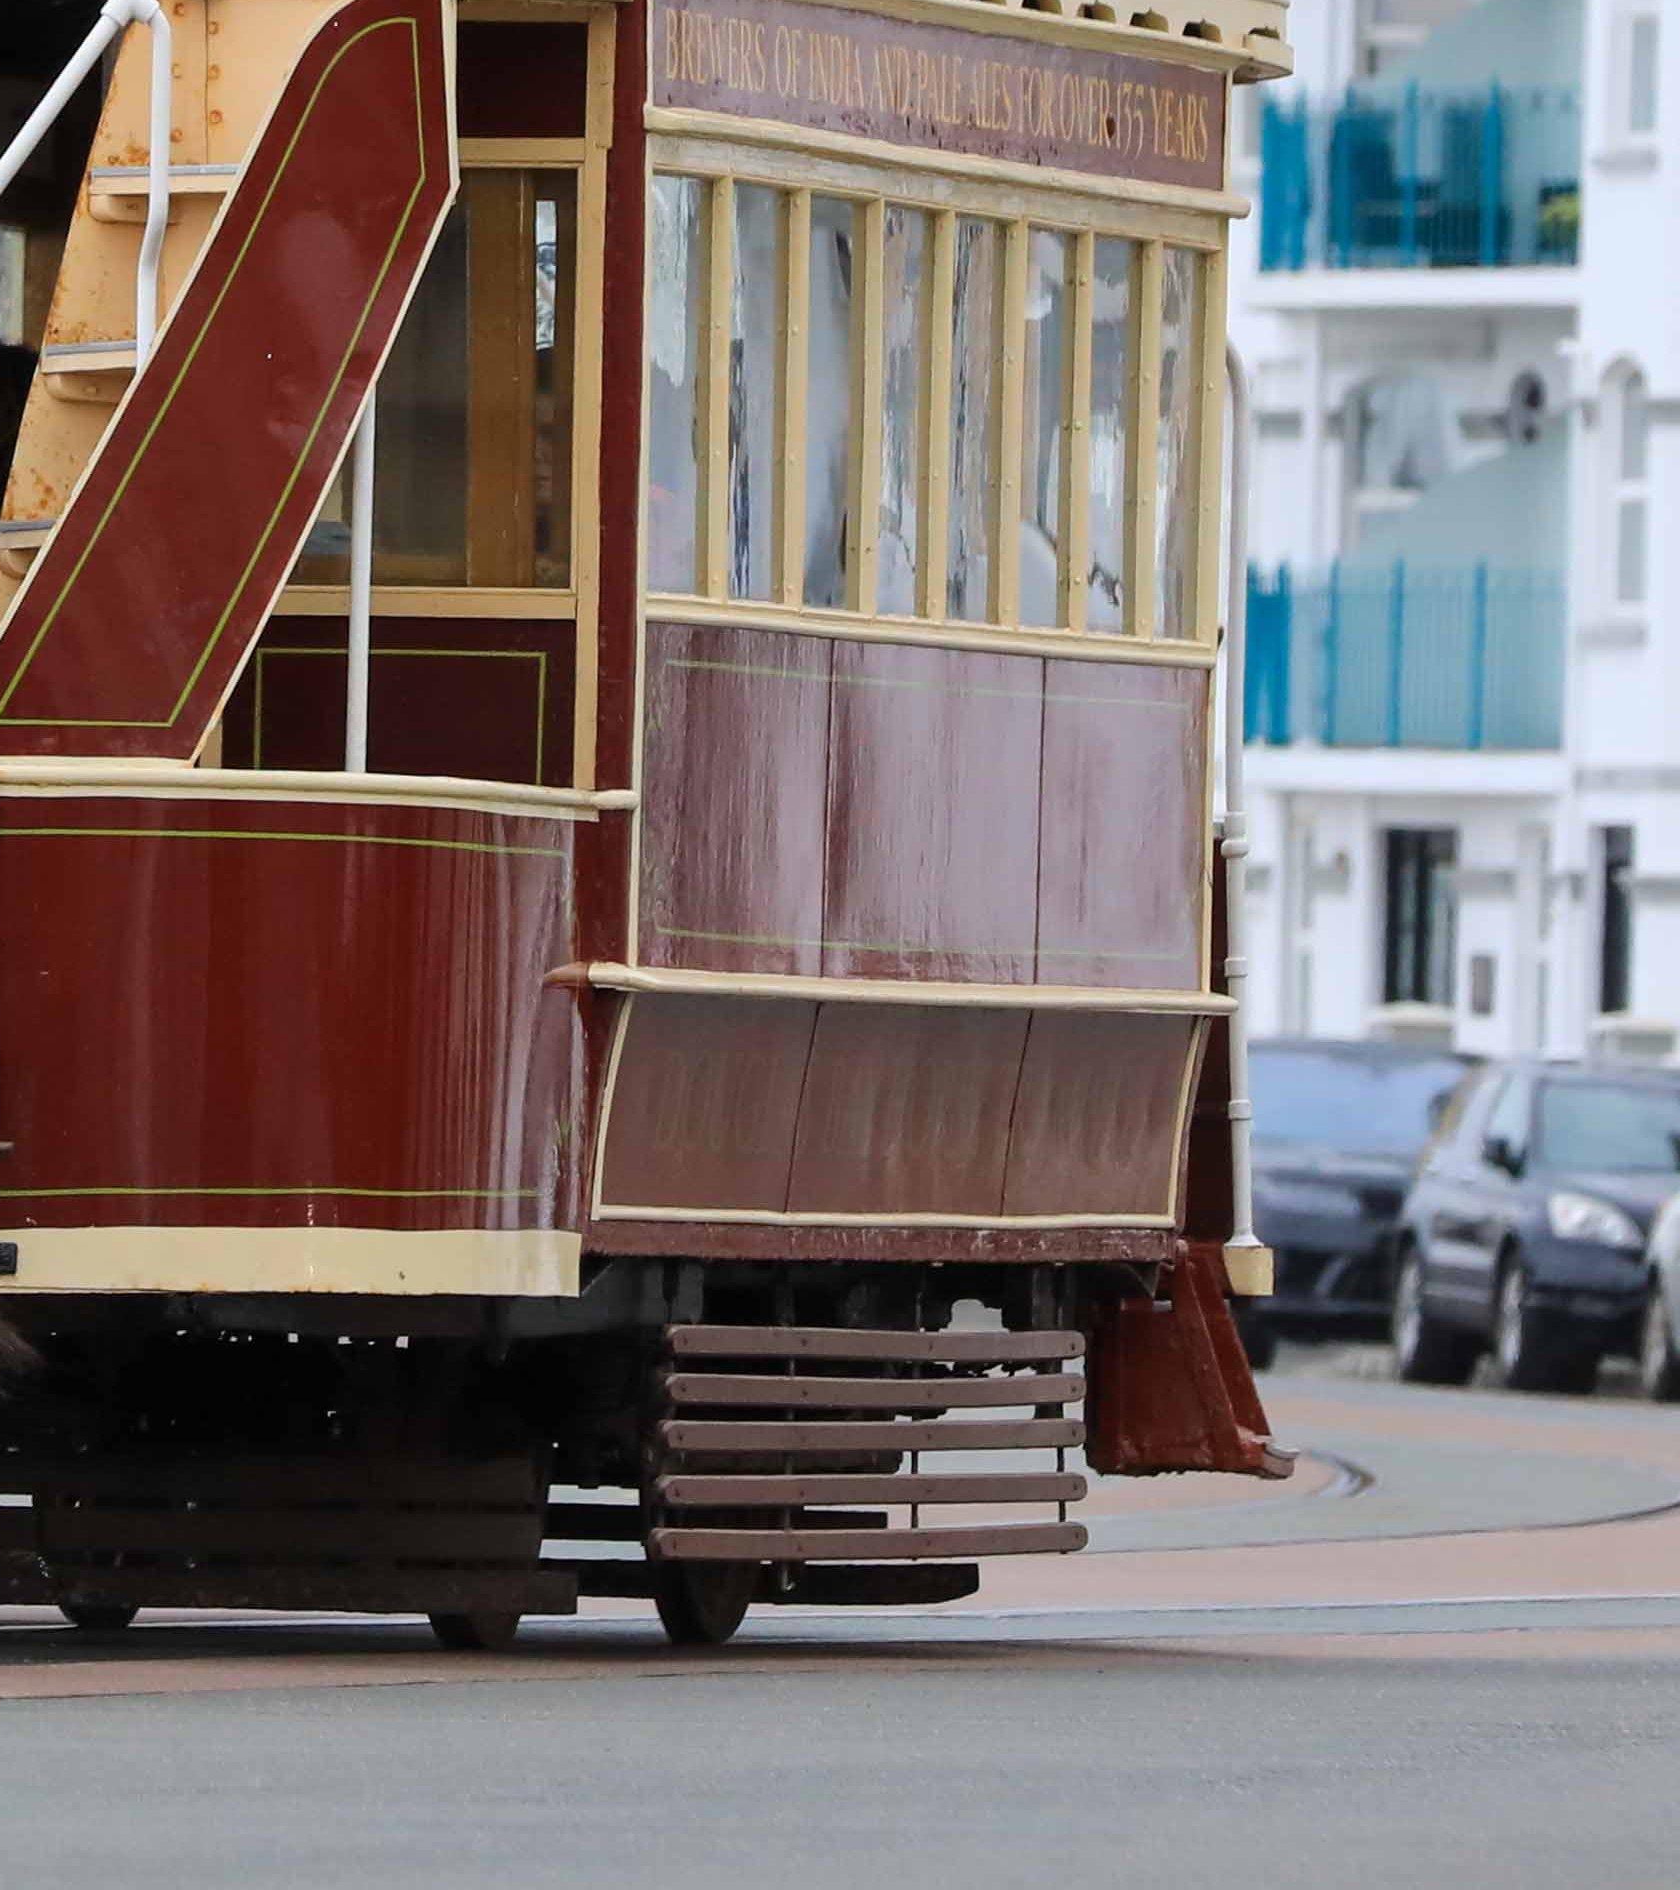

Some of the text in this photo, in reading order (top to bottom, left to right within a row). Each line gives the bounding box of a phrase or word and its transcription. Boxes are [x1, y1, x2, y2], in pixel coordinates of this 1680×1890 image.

[664, 6, 767, 94] BREWERS
[774, 24, 803, 100] OF
[807, 31, 865, 109] INDIA
[869, 41, 913, 116] AND
[916, 47, 963, 126] PALE
[968, 60, 1013, 132] ALES
[1016, 65, 1057, 140] FOR
[1058, 71, 1112, 149] OVER
[1149, 85, 1210, 163] YEARS
